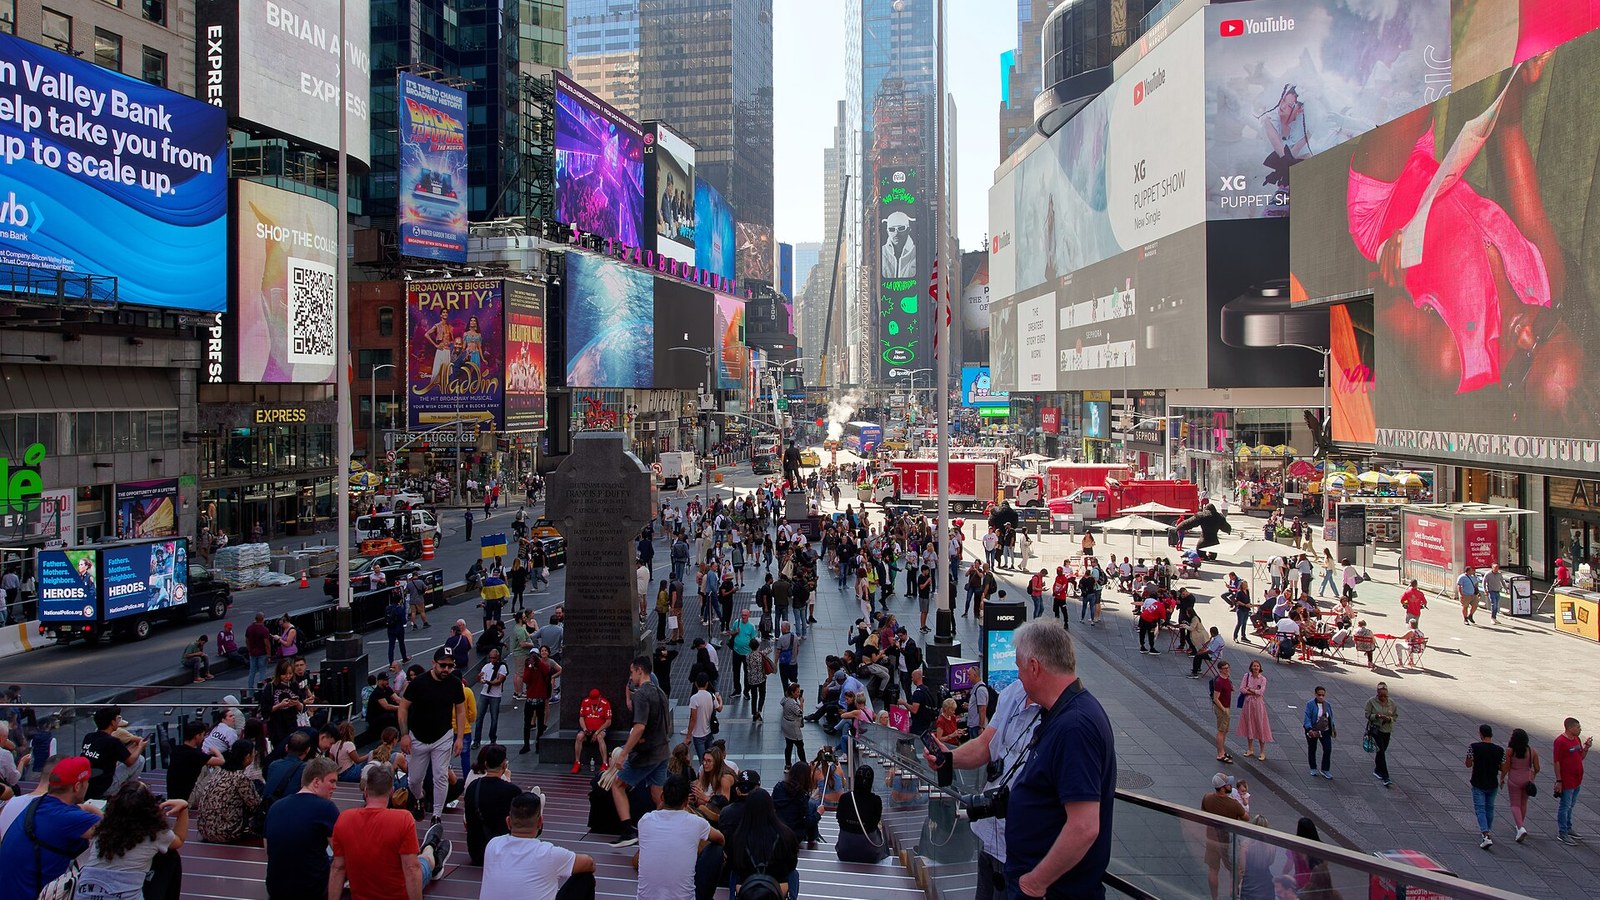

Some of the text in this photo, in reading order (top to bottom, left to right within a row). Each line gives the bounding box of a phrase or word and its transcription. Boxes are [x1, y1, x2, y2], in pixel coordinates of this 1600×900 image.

[1246, 16, 1295, 35] YouTube
[266, 1, 370, 79] BRIAN AWO
[207, 25, 223, 107] EXPRES
[1423, 44, 1452, 105] SIC
[406, 79, 463, 104] IT'S TIME TO CHANGE
[1144, 67, 1166, 97] YouTube
[22, 59, 106, 117] Valley
[111, 88, 173, 133] Bank
[406, 87, 463, 110] BROADWAY HISTORY!
[404, 96, 464, 132] BACK
[0, 94, 213, 174] elp take you from
[423, 126, 464, 144] FUTURE
[31, 137, 62, 168] to
[67, 156, 136, 186] scale
[141, 169, 176, 198] up.
[1133, 159, 1146, 184] XG
[1133, 169, 1187, 211] PUPPET SHOW
[1220, 175, 1246, 191] XG
[1220, 193, 1290, 208] PUPPET SH
[1133, 209, 1161, 230] New Single
[10, 230, 29, 241] Bank
[256, 222, 337, 254] SHOP THE COLLE
[608, 236, 736, 295] 1540 BROADWAY
[410, 281, 500, 292] BROADWAY'S BIGGEST
[418, 291, 493, 311] PARTY!
[968, 296, 982, 304] THE
[209, 313, 223, 383] PRES
[412, 361, 499, 396] Aladdin
[1338, 364, 1376, 394] aer
[256, 408, 306, 423] EXPRESS
[395, 433, 416, 443] FTS
[1135, 431, 1159, 442] SEPHORA
[1376, 429, 1600, 463] AMERICAN EAGLE OUTFITT
[126, 489, 152, 497] OPPORTUNITY
[566, 489, 631, 498] FRANCIS DUFFY
[1422, 533, 1442, 544] Broadway
[43, 560, 68, 568] Fathers.
[108, 557, 130, 566] Fathers.
[108, 565, 132, 574] Mothers.
[43, 577, 76, 585] Neighbors.
[108, 572, 138, 583] Neighbors.
[43, 588, 87, 598] HEROES.
[108, 581, 147, 597] HEROES.
[109, 602, 145, 614] NationalPolice.org
